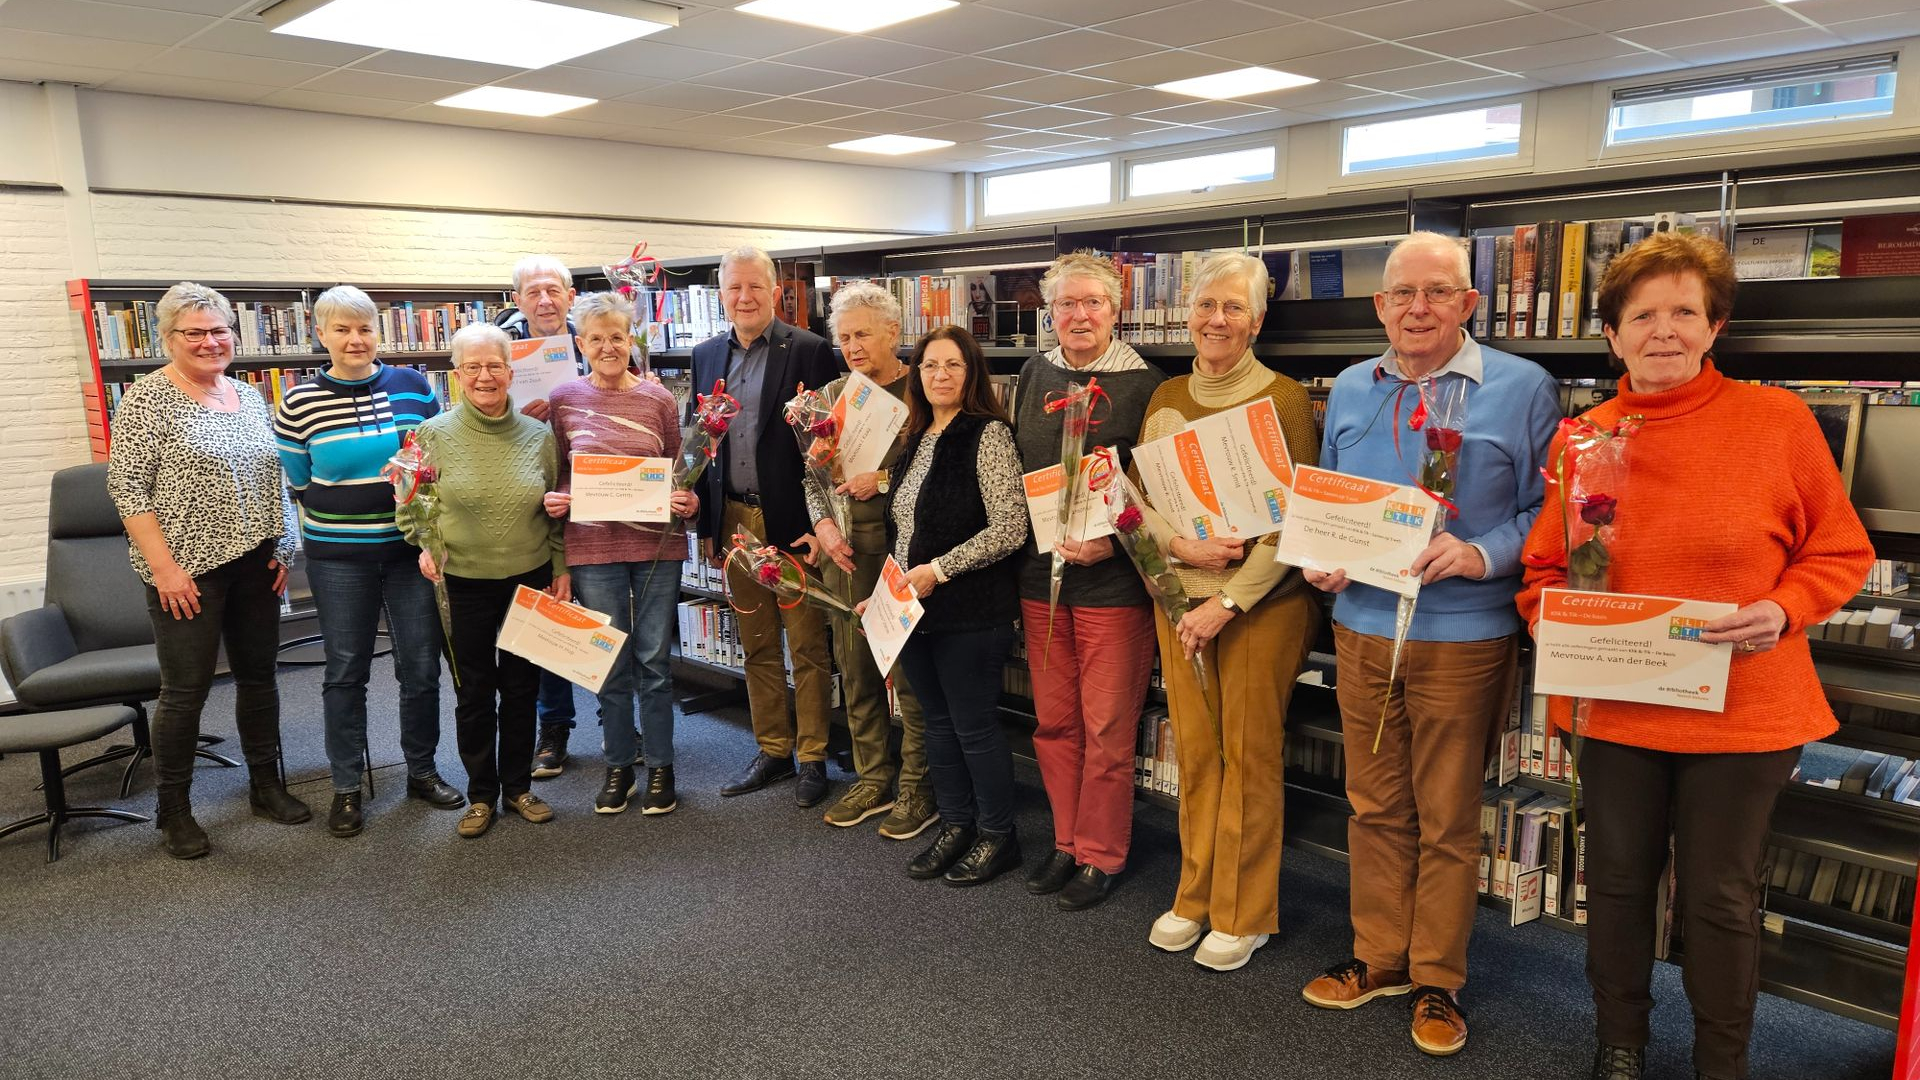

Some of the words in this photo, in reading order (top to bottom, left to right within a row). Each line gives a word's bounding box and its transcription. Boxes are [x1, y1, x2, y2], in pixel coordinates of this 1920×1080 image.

[1753, 237, 1766, 246] DE
[1264, 414, 1286, 469] Certificaat
[1221, 436, 1233, 466] Mevrouw
[583, 458, 628, 466] Certificaat
[1189, 443, 1212, 496] Certificaat
[1033, 468, 1061, 483] Certific
[1309, 472, 1370, 493] Certificaat
[1276, 488, 1286, 513] KLI
[1387, 502, 1425, 516] KLIK
[1270, 500, 1282, 522] TIK
[1204, 516, 1214, 536] KLI
[1326, 512, 1371, 529] Gefeliciteerd!
[1314, 528, 1330, 537] heer
[1338, 533, 1347, 541] de
[1349, 536, 1370, 546] Gunst
[1562, 595, 1645, 610] Certificaat
[1672, 617, 1704, 628] KLI
[1590, 636, 1652, 648] Gefeliciteerd!
[1550, 651, 1594, 662] Mevrouw
[1626, 656, 1642, 664] der
[1645, 658, 1668, 667] Beek
